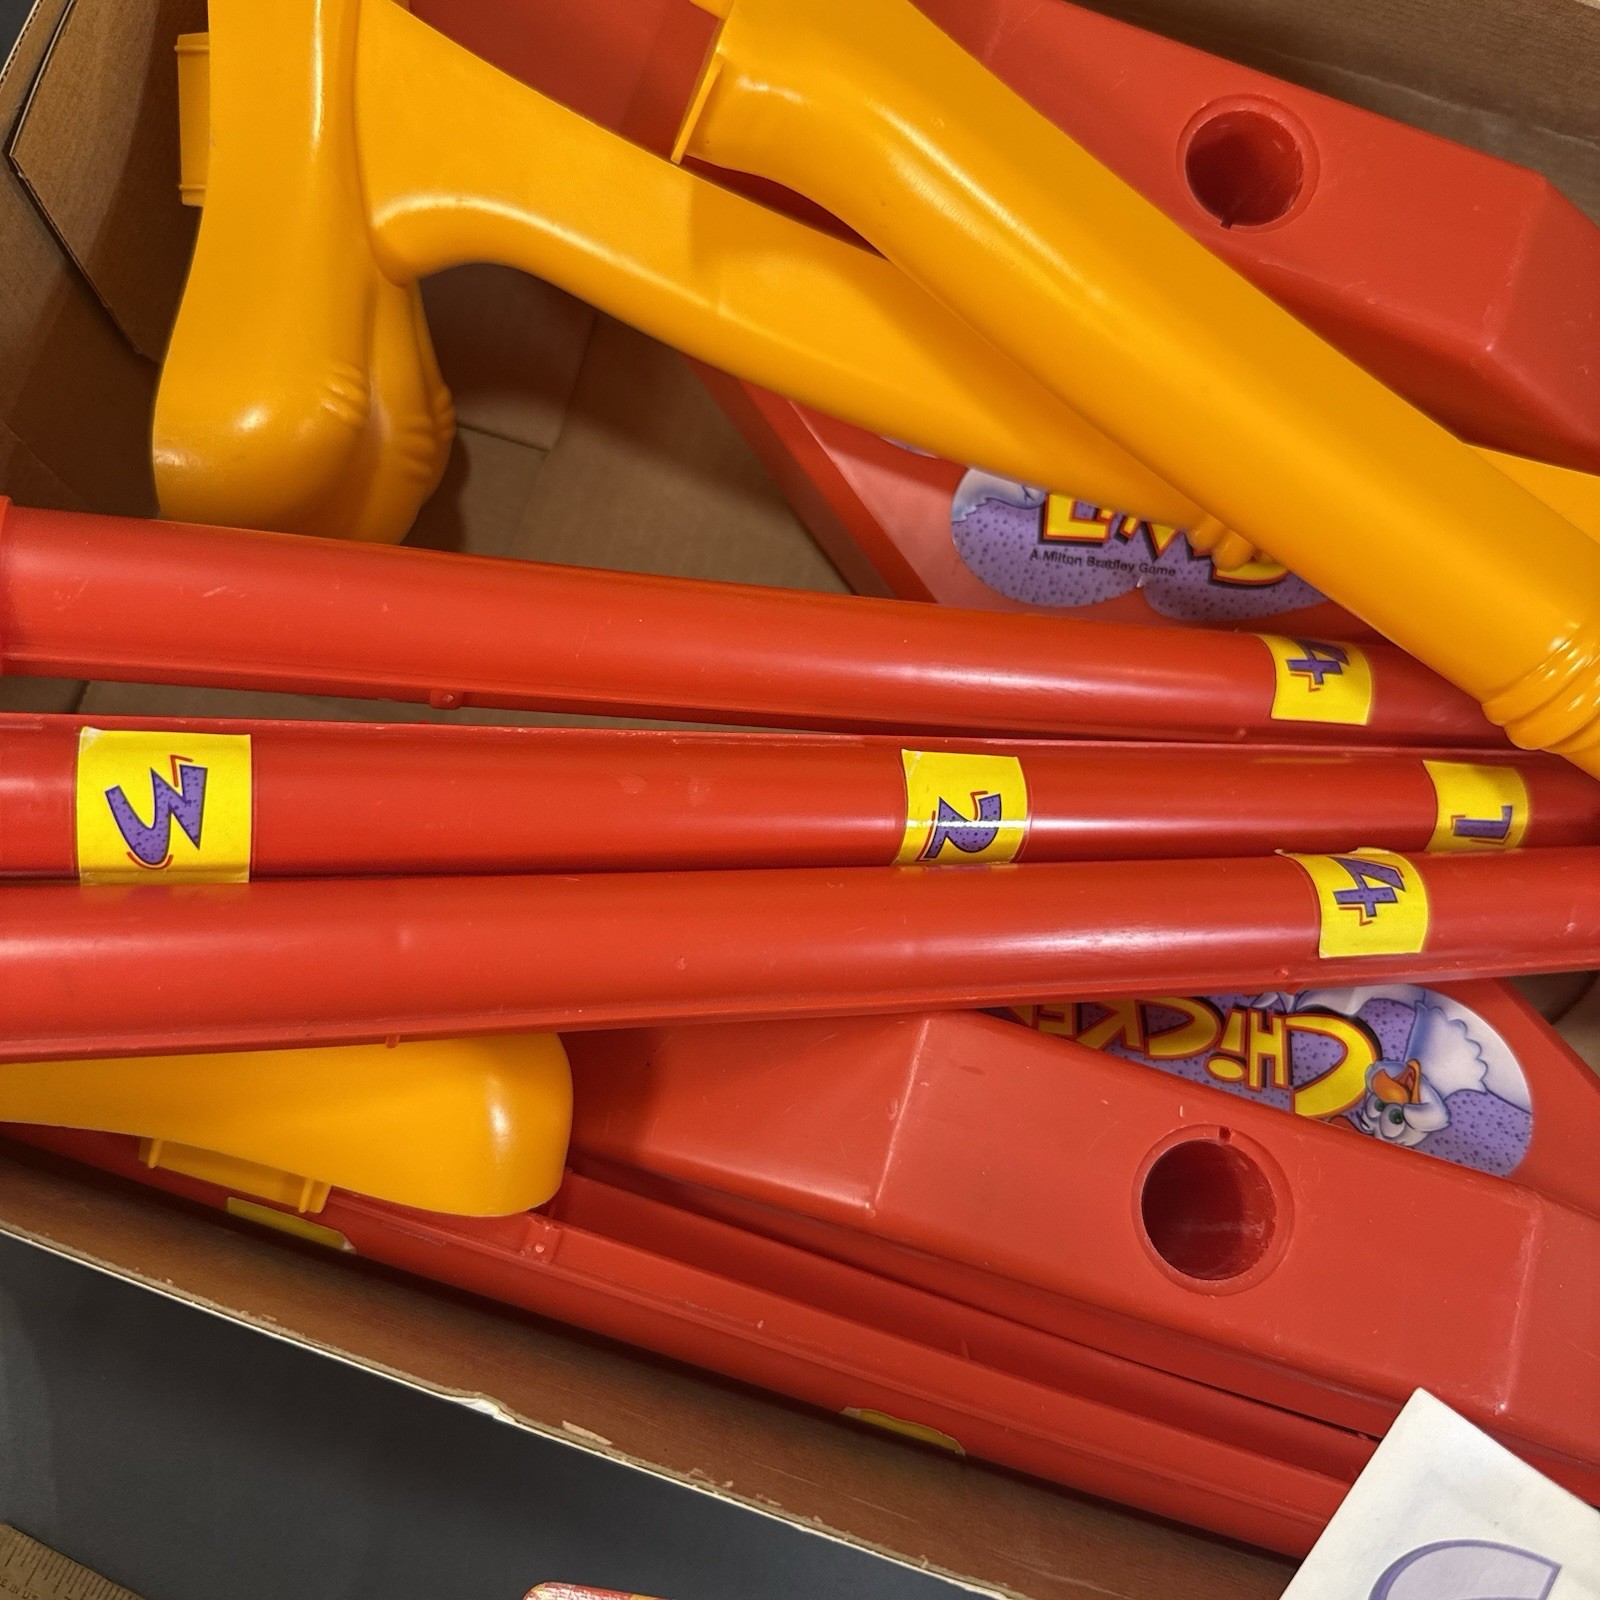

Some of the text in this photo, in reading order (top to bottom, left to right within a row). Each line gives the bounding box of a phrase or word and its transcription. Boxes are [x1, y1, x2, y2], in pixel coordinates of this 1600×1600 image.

[1029, 547, 1176, 577] A Milton Bradley Game
[1286, 638, 1350, 690] 4
[915, 791, 1002, 862] 2
[1327, 856, 1406, 925] 4
